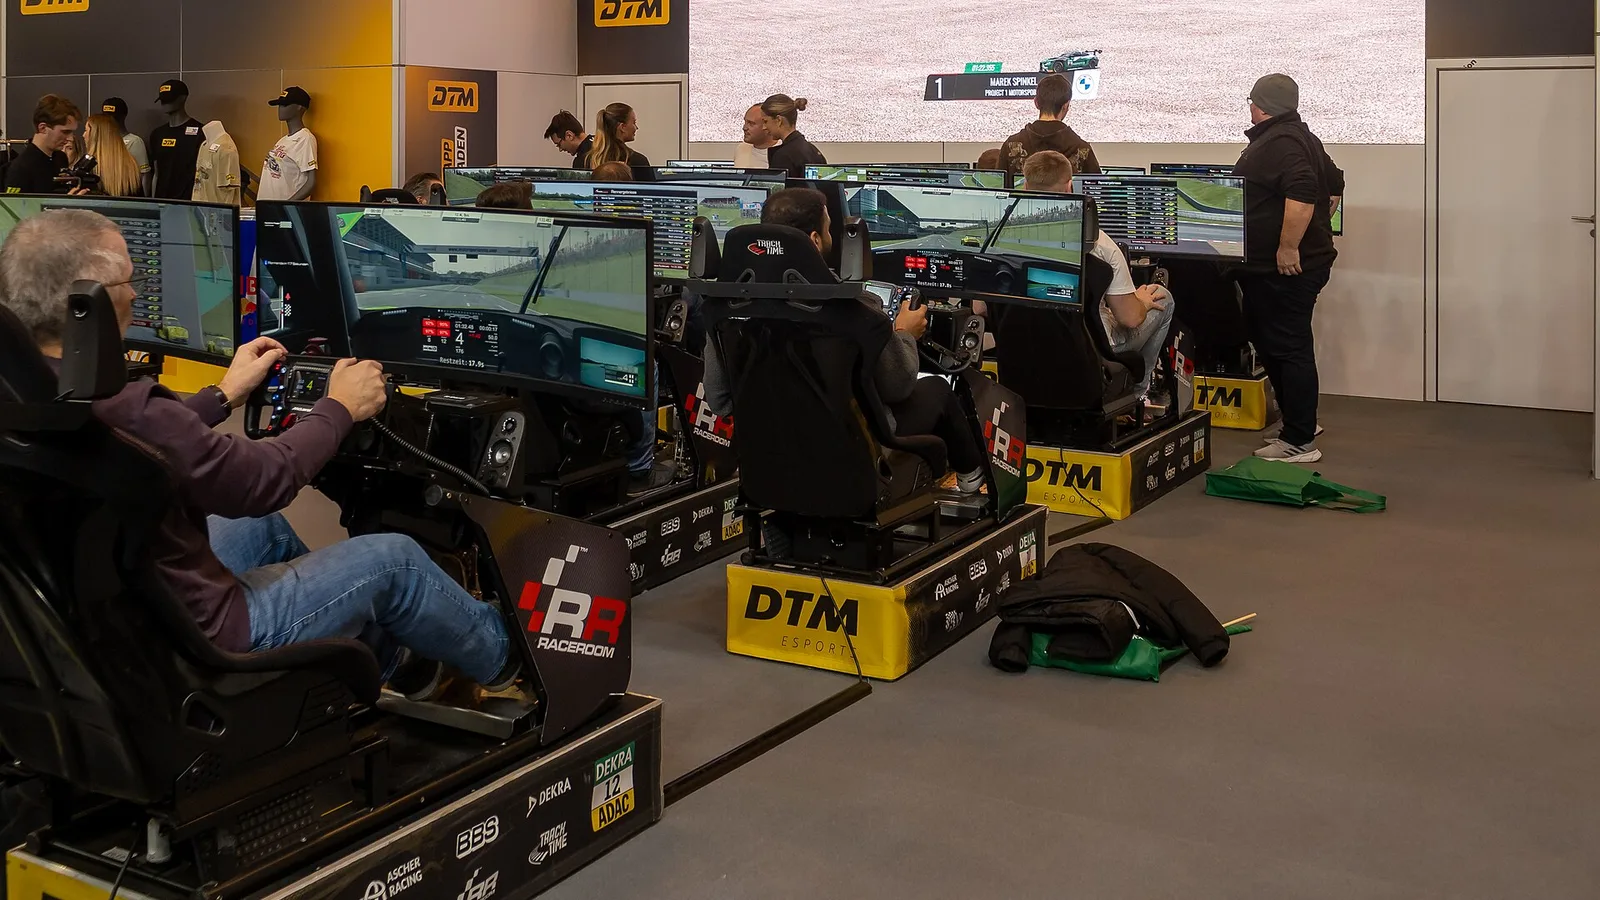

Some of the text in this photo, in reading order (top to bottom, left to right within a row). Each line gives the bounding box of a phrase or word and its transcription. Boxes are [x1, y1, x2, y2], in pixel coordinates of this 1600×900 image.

[600, 0, 662, 20] DTM
[935, 77, 943, 99] 1
[990, 77, 1038, 87] MAREK SPINKEL
[1009, 88, 1036, 97] MOTORSPOR
[431, 86, 474, 107] DTM
[457, 129, 466, 168] ADEN
[757, 239, 781, 249] TRACK
[766, 247, 784, 255] TIME
[930, 264, 937, 274] 3
[455, 332, 465, 345] 4
[439, 356, 468, 366] Restzeit:
[306, 380, 314, 391] 4
[622, 374, 629, 382] 4
[1196, 385, 1242, 408] TM
[692, 427, 731, 448] RACEROOM
[991, 456, 1021, 478] RACEROOM
[1025, 457, 1102, 492] DTM
[698, 506, 714, 519] DEKRA
[661, 517, 680, 537] BBS
[724, 523, 741, 539] ADAC
[969, 558, 988, 581] BBS
[744, 584, 860, 637] DTM
[536, 637, 616, 659] RACEROOM
[596, 747, 633, 783] DEKRA
[539, 777, 572, 806] DEKRA
[603, 774, 621, 801] 12
[598, 795, 631, 829] ADAC
[456, 815, 500, 860] BBS
[539, 821, 567, 848] TRACK
[549, 833, 568, 857] TIME
[386, 857, 421, 885] ASCHER
[389, 871, 423, 898] RACING
